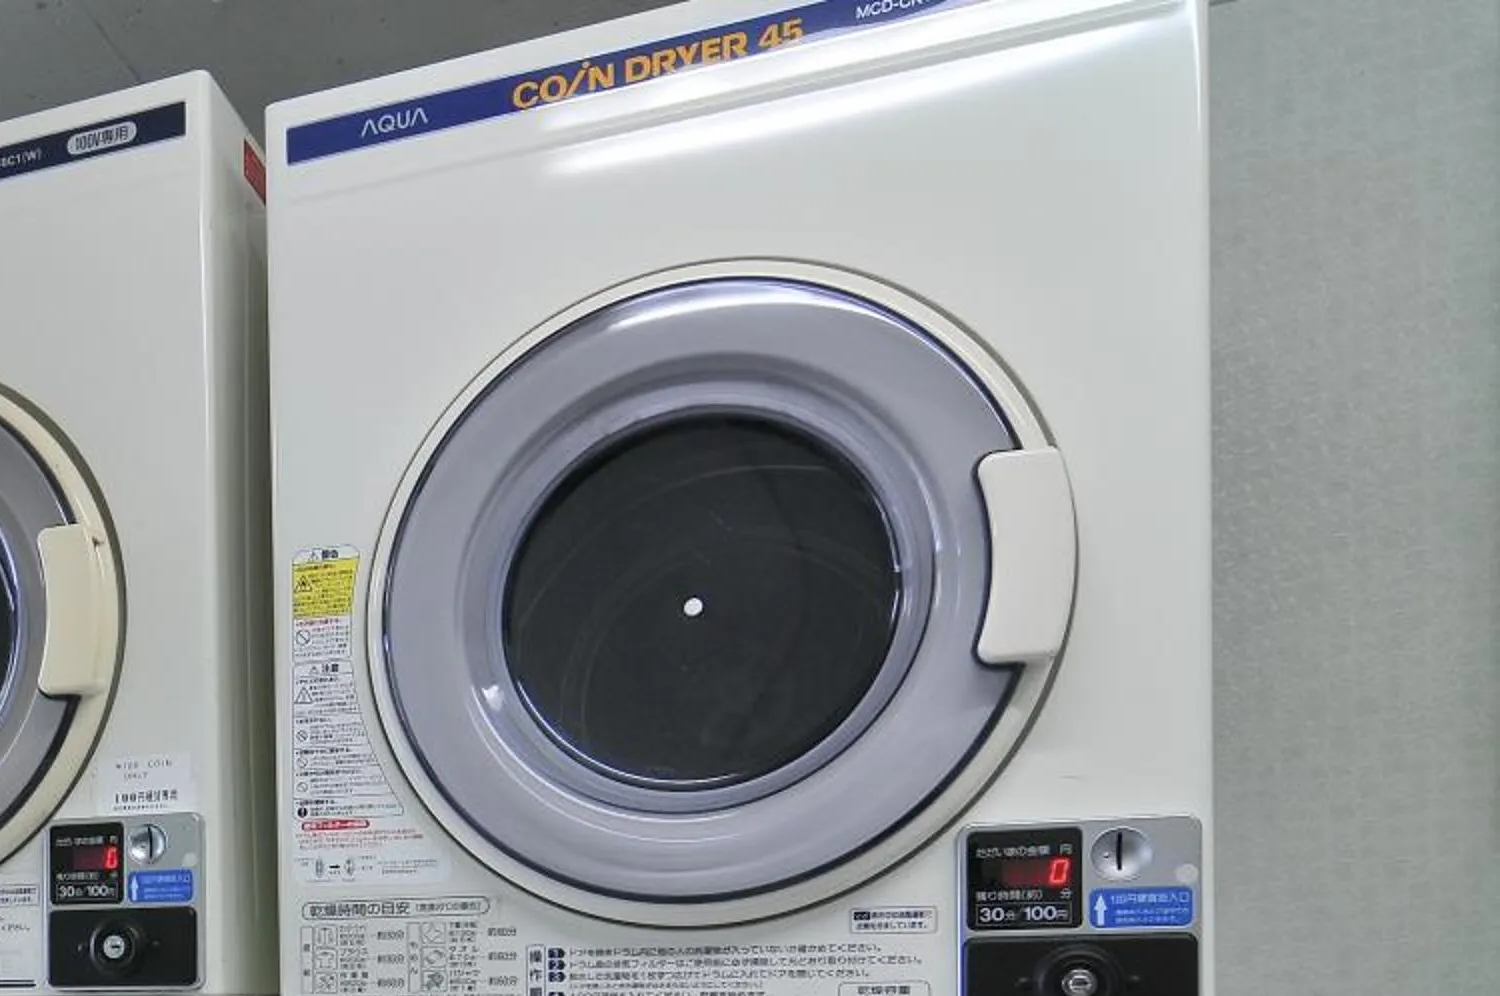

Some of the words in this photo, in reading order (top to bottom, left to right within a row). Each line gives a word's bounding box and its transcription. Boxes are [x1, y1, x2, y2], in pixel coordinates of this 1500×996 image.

[361, 106, 429, 138] AQUA
[513, 61, 615, 111] COIN
[624, 31, 749, 86] DRYER
[757, 18, 804, 50] 45
[1049, 858, 1070, 886] 0
[979, 907, 1016, 922] 30分
[1024, 905, 1069, 921] 100円
